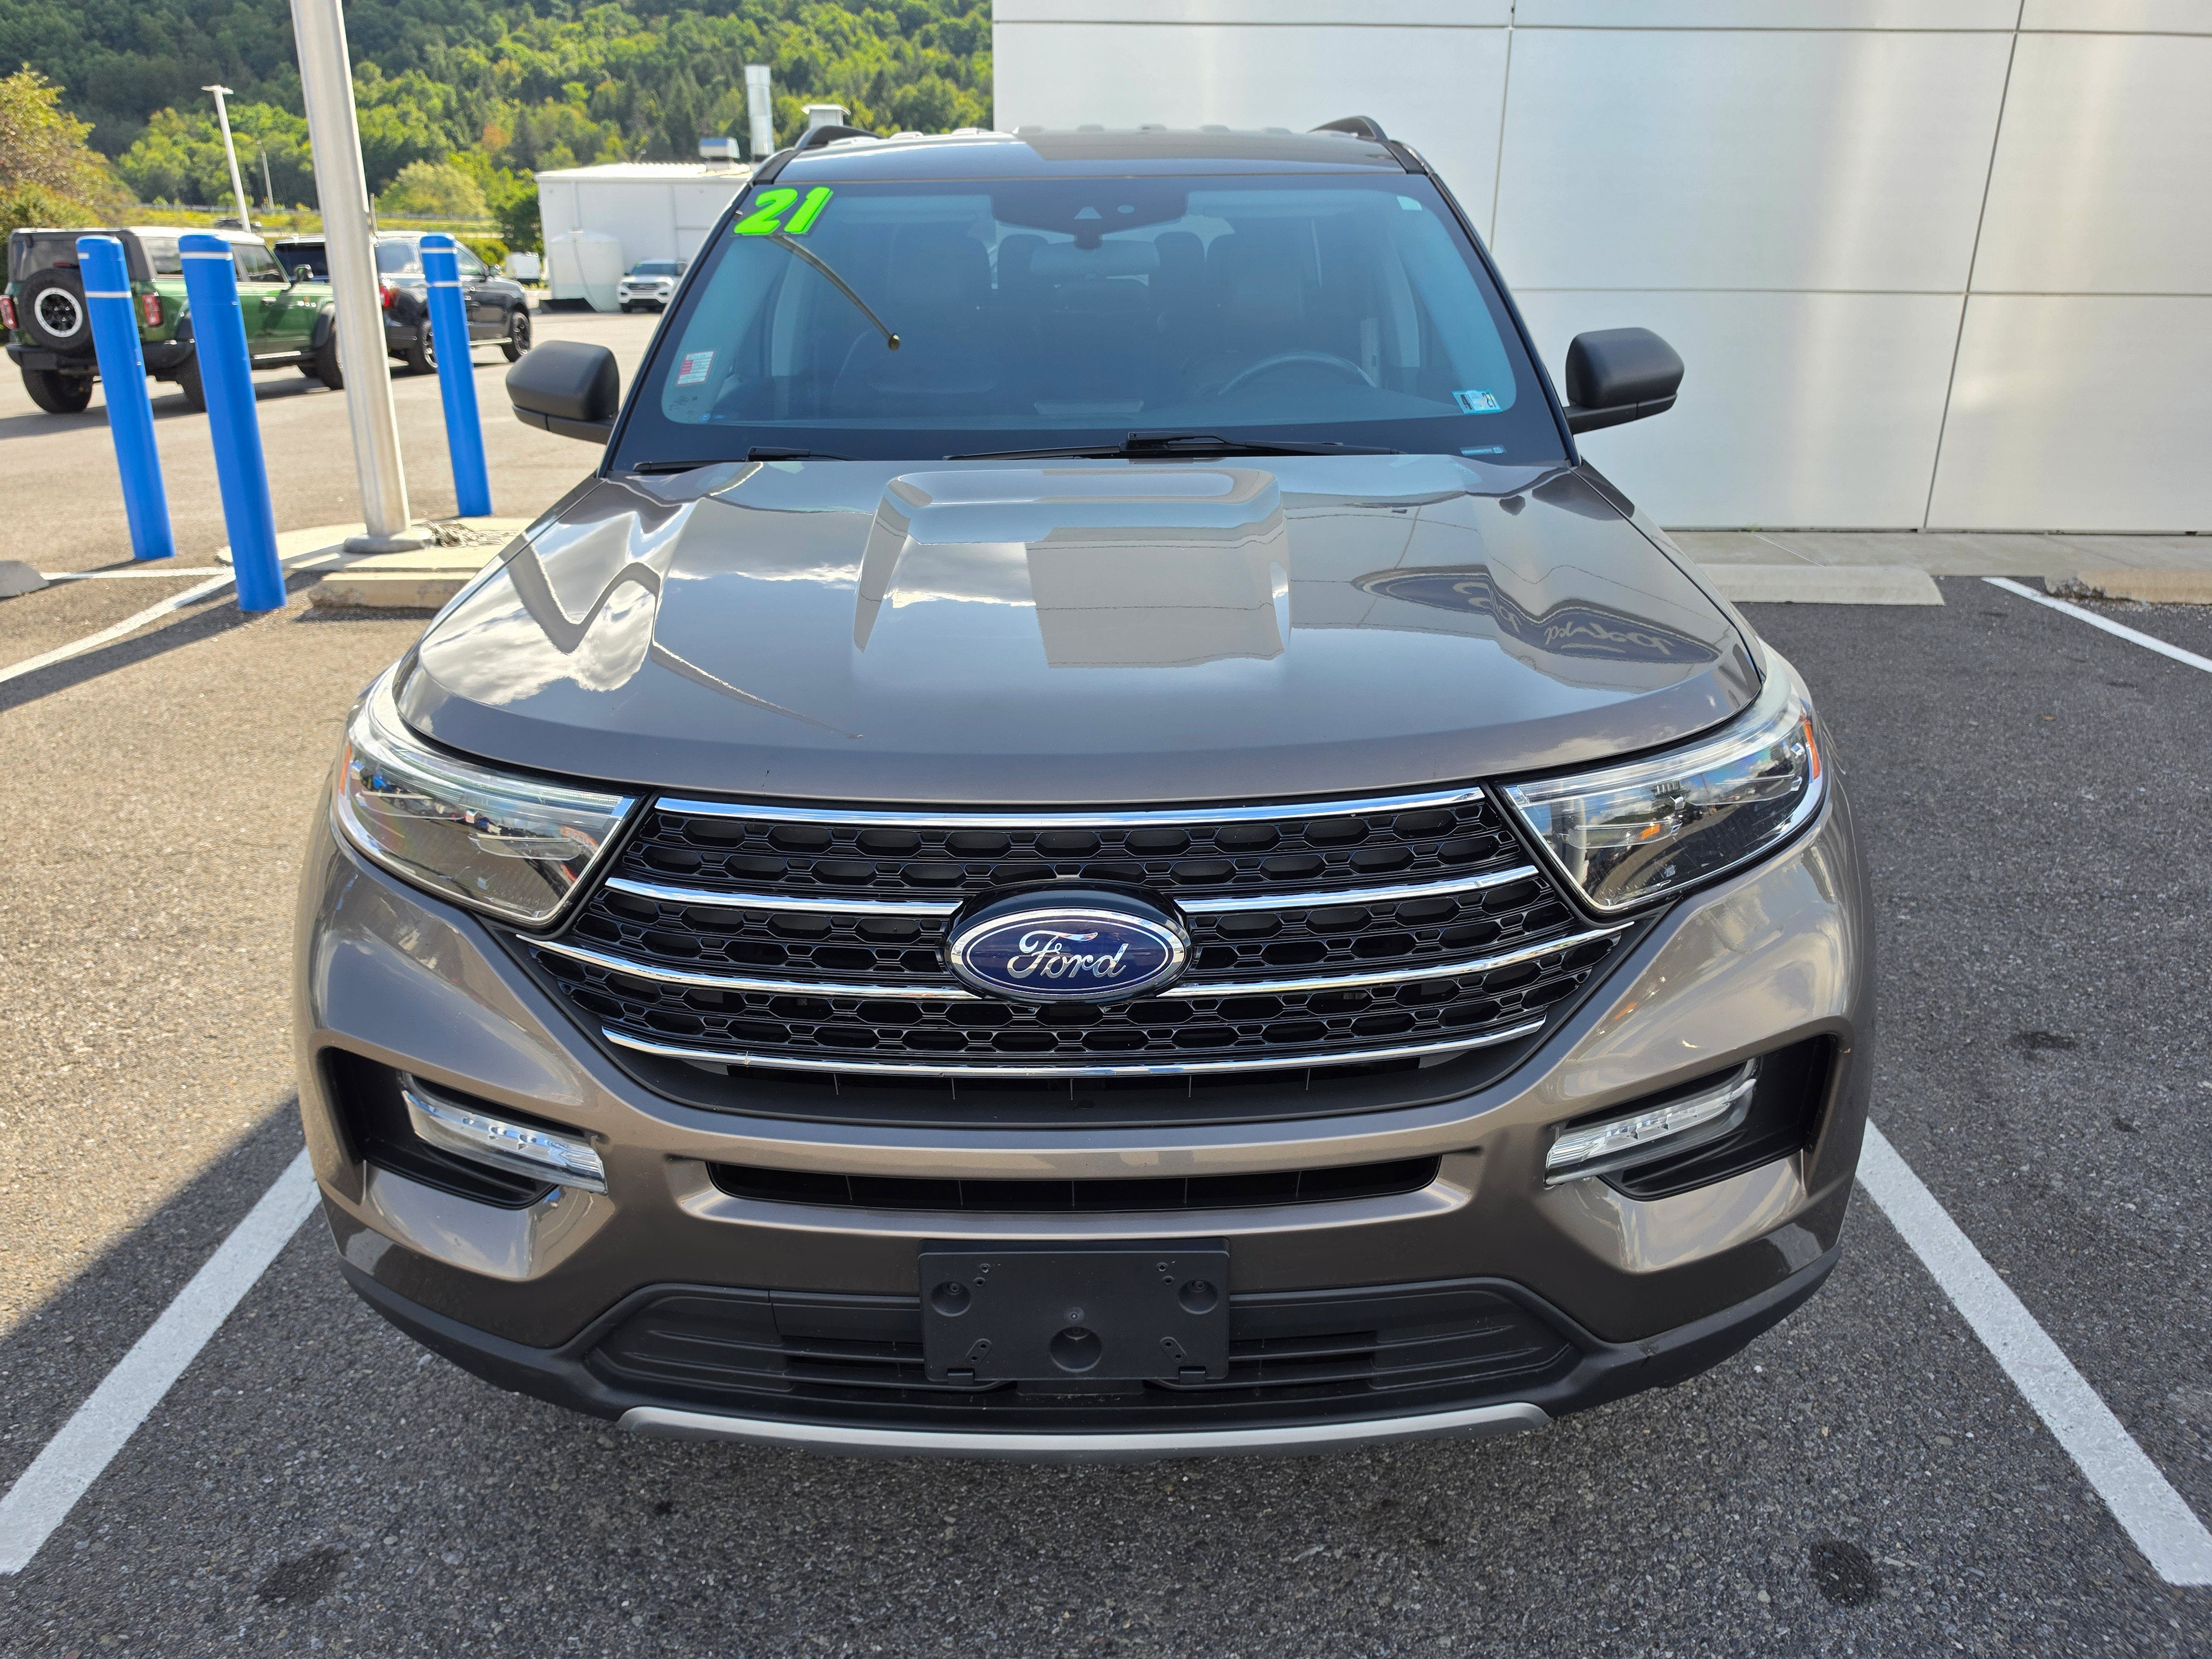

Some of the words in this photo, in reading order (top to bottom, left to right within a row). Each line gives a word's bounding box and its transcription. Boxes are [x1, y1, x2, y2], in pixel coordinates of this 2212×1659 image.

[734, 186, 833, 236] 21
[1460, 394, 1472, 410] 4
[1481, 392, 1496, 408] 27
[1006, 930, 1129, 979] Ford
